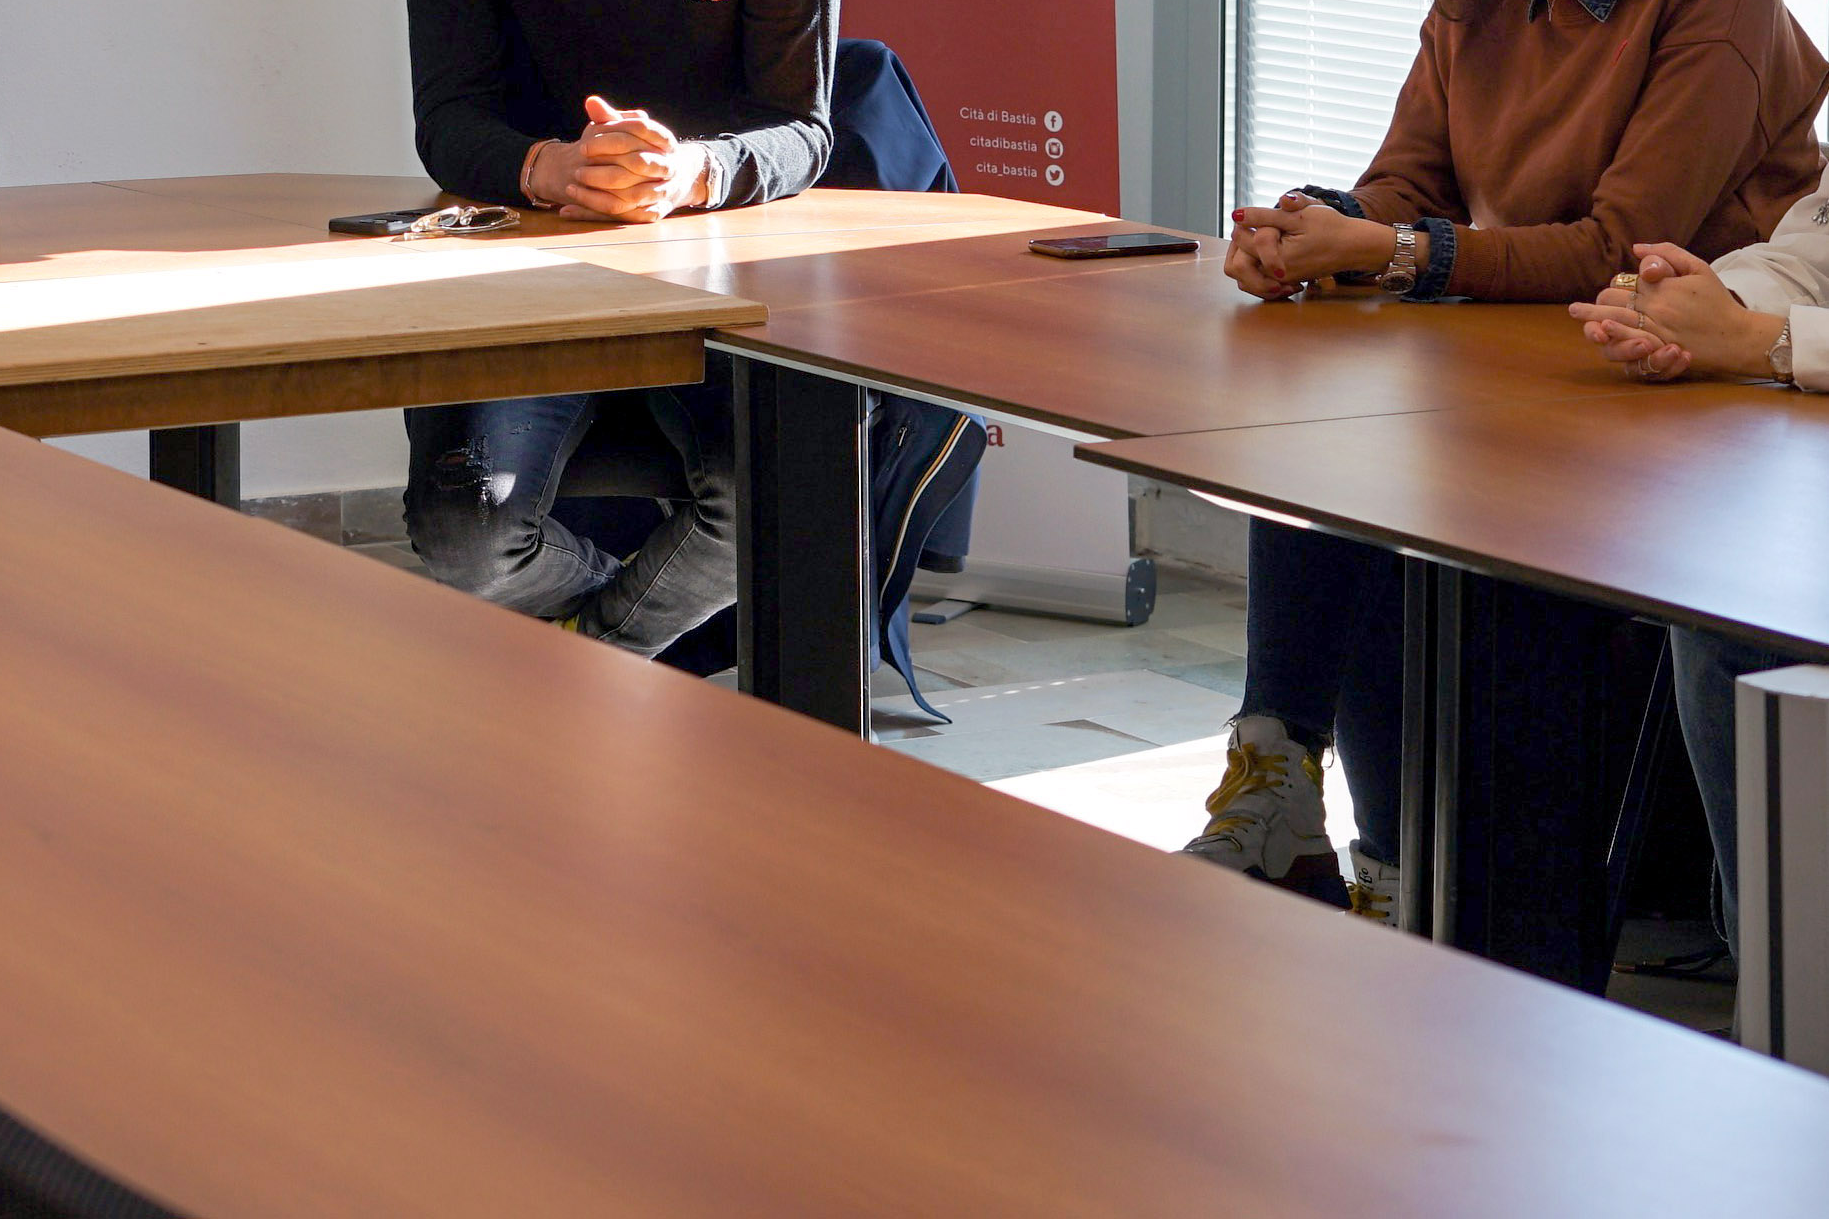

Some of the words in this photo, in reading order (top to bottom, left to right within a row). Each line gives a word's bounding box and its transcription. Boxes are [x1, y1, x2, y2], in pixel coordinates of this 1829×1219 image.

[959, 106, 984, 119] Cità
[987, 110, 998, 121] di
[1001, 110, 1036, 125] Bastia
[969, 136, 1038, 152] citadibastia
[976, 162, 1038, 178] cita_bastia
